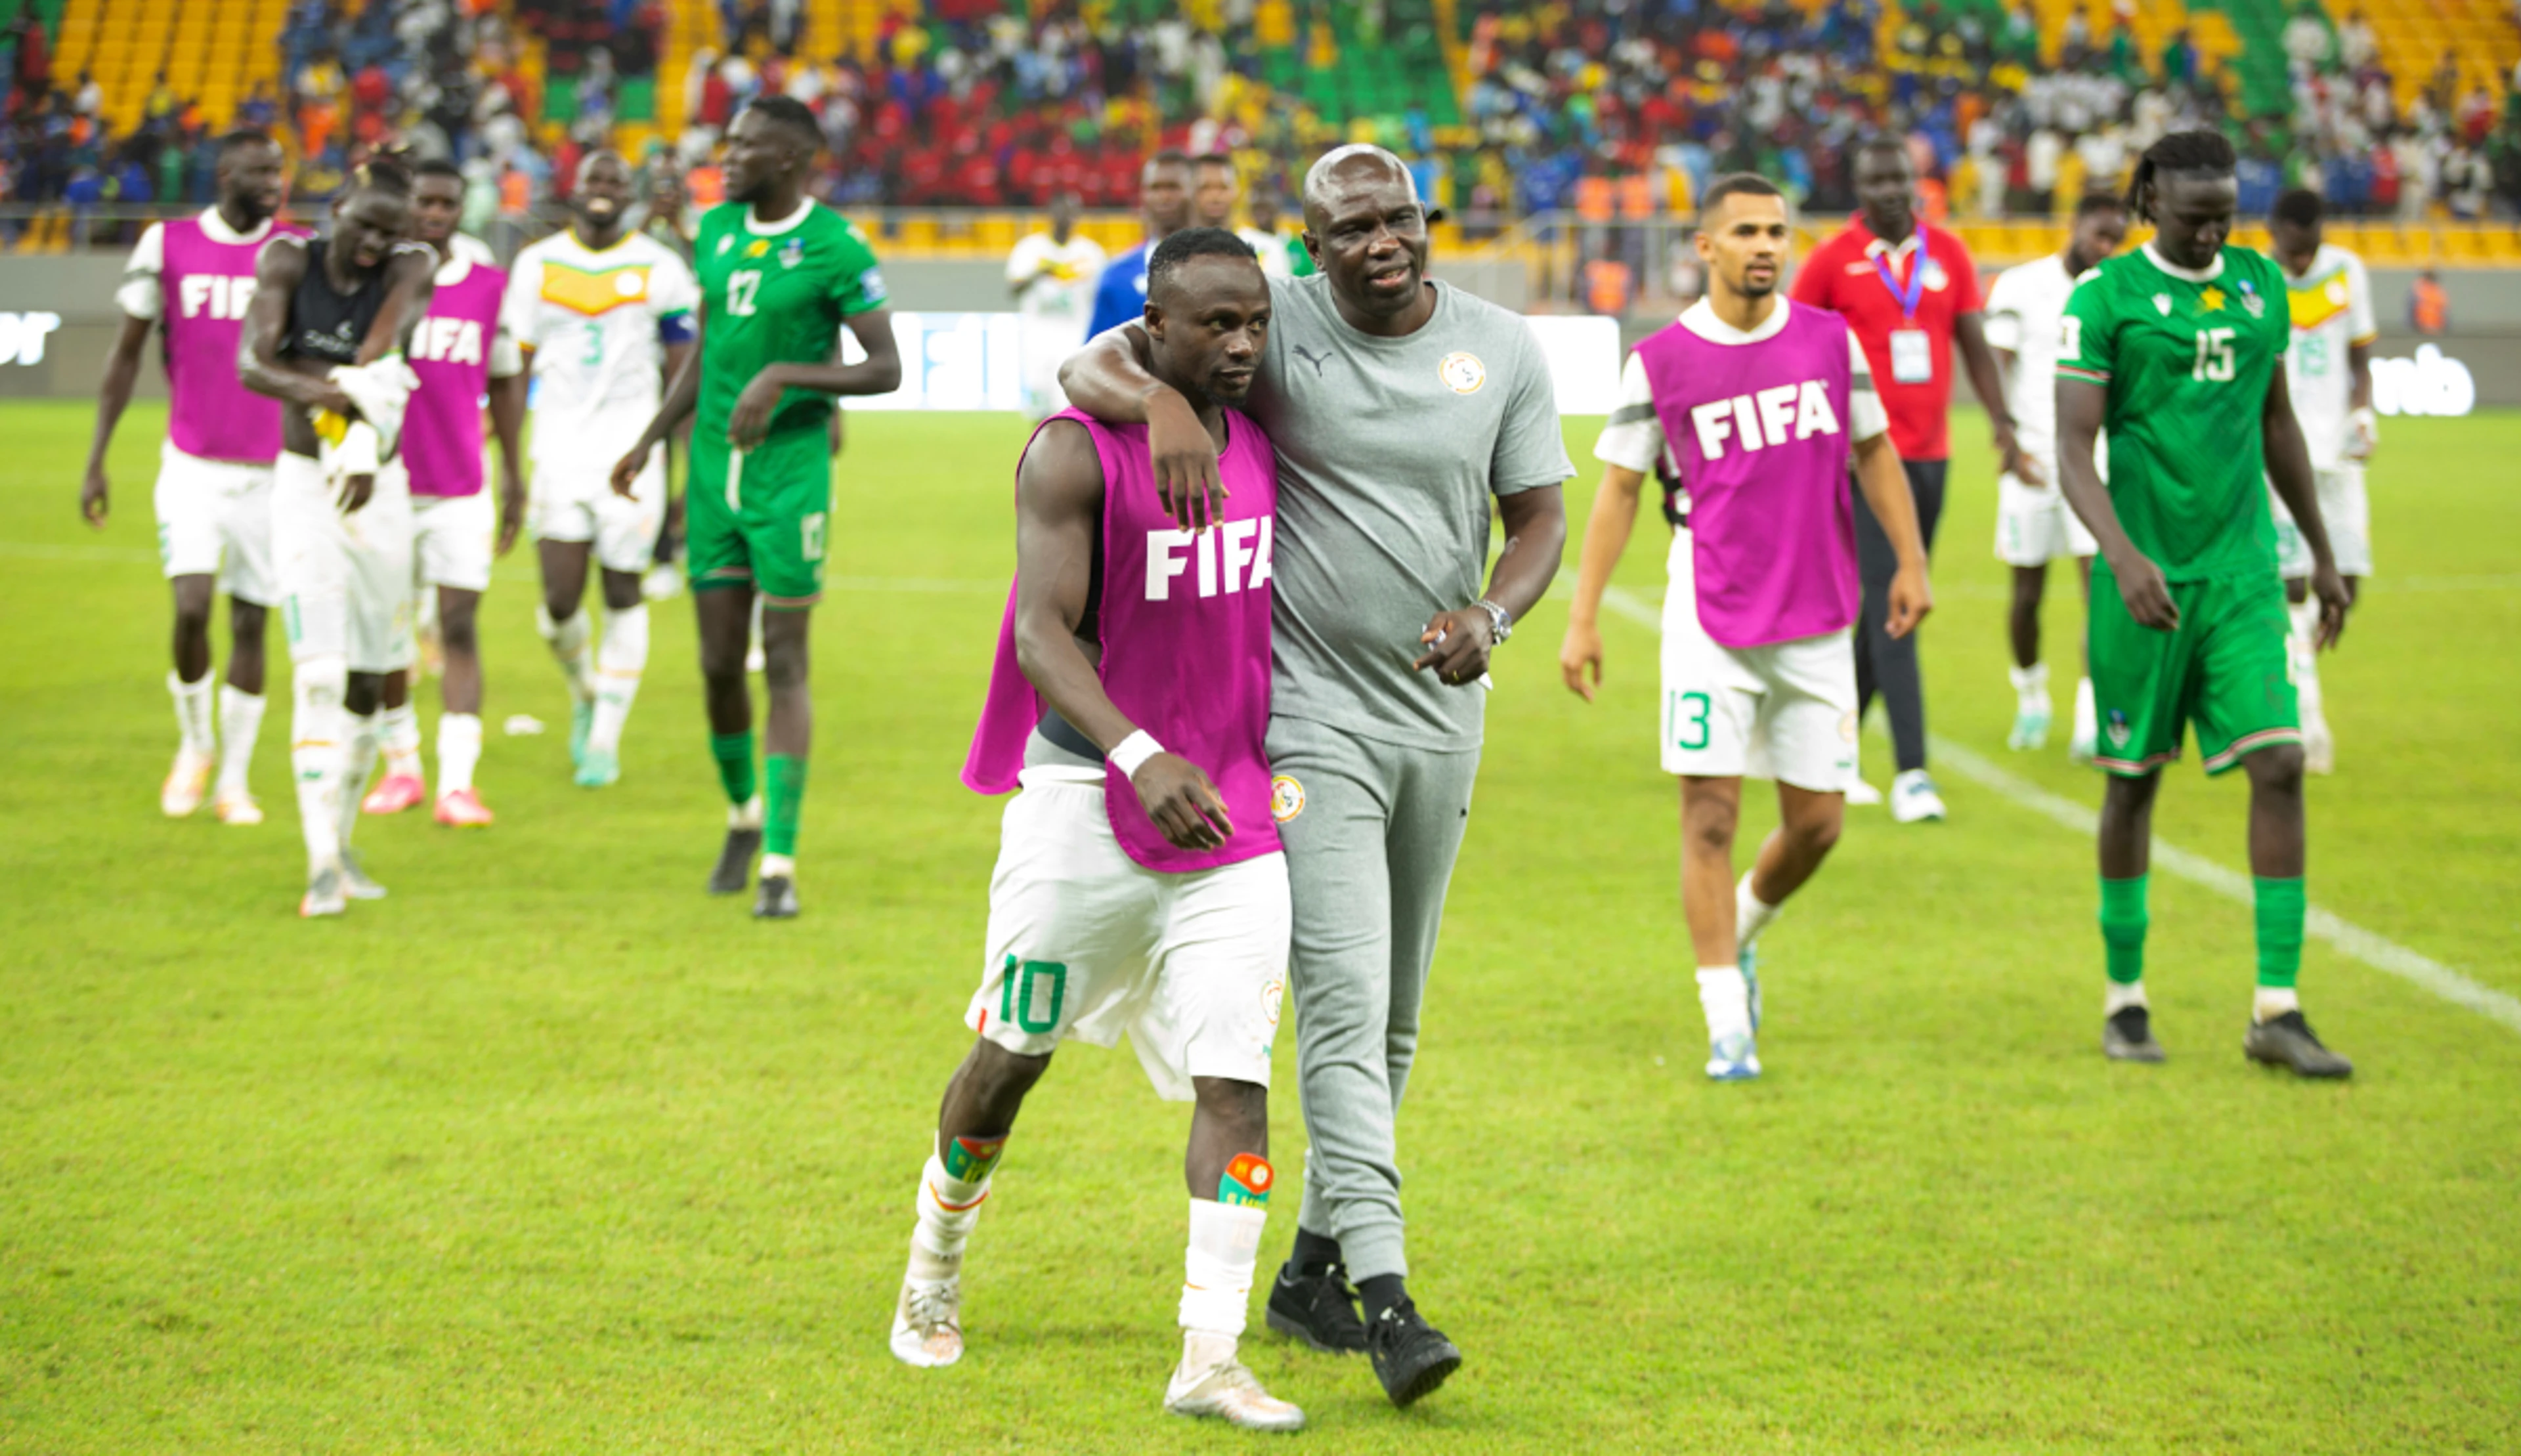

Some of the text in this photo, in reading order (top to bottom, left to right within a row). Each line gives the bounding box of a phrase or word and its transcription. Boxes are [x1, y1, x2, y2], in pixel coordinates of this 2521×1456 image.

[180, 273, 259, 320] FIF
[409, 316, 483, 366] IFA
[2192, 327, 2236, 382] 15
[1691, 379, 1840, 461] FIFA
[1669, 689, 1711, 751] 13
[1000, 953, 1067, 1035] 10
